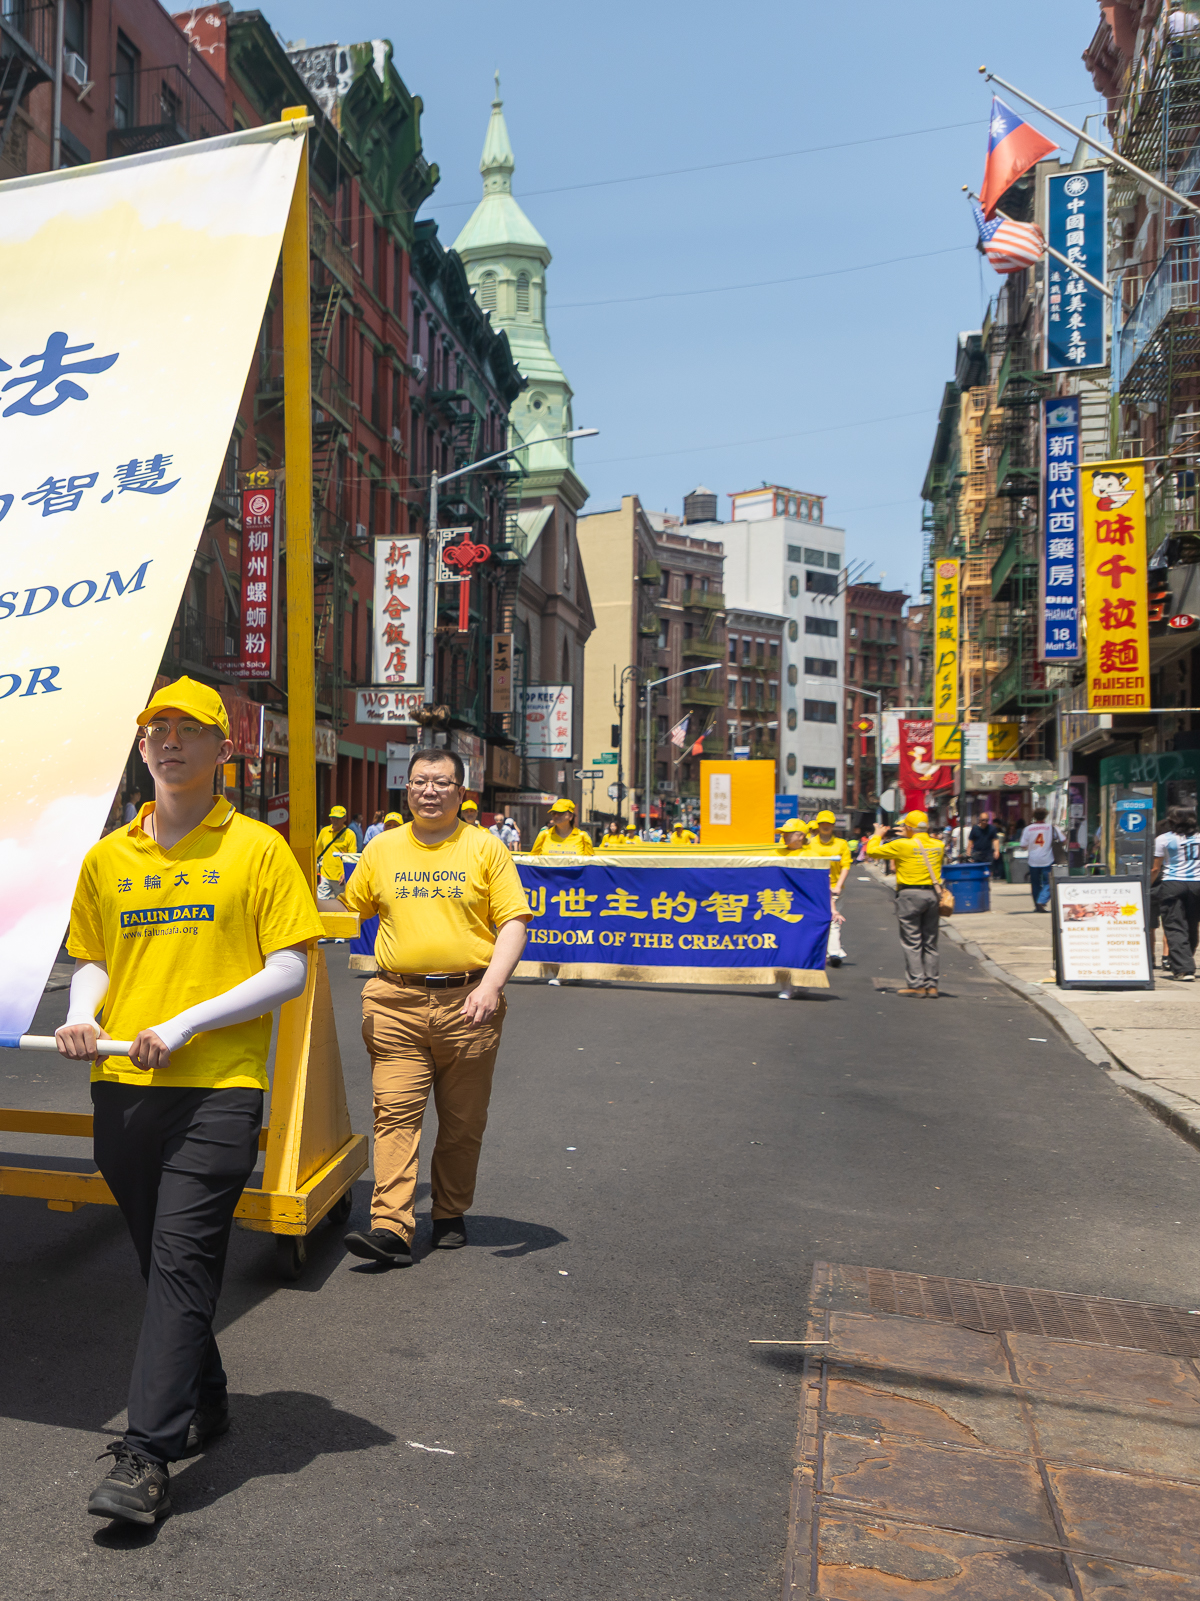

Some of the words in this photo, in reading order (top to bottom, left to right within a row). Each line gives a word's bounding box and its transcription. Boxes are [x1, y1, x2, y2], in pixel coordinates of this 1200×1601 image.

[246, 470, 270, 486] 13
[1048, 434, 1075, 587] 新時代西藥房
[246, 515, 271, 526] SILK
[245, 531, 268, 654] 柳州螺蛳粉
[1095, 514, 1139, 674] 味千拉麵
[382, 541, 411, 673] 新和合飯店
[1045, 608, 1078, 620] PHARMACY
[1174, 616, 1188, 626] 16
[1052, 628, 1070, 641] 18
[1045, 642, 1064, 650] Mott
[246, 660, 267, 669] Spicy
[251, 669, 270, 677] Soup
[1093, 676, 1145, 691] AJISEN
[361, 693, 389, 708] WO
[538, 692, 554, 702] KEE
[1093, 694, 1145, 708] RAMEN
[1128, 813, 1142, 830] P
[1034, 833, 1045, 848] 4
[117, 869, 220, 894] 法輪大法
[394, 871, 430, 882] FALUN
[432, 870, 466, 882] GONG
[395, 885, 464, 899] 法輪大法
[123, 910, 169, 925] FALUN
[173, 907, 210, 920] DAFA
[122, 925, 198, 940] www.falundafa.org
[527, 929, 594, 945] ISDOM
[599, 931, 627, 946] OF
[630, 932, 674, 949] THE
[678, 933, 778, 950] CREATOR
